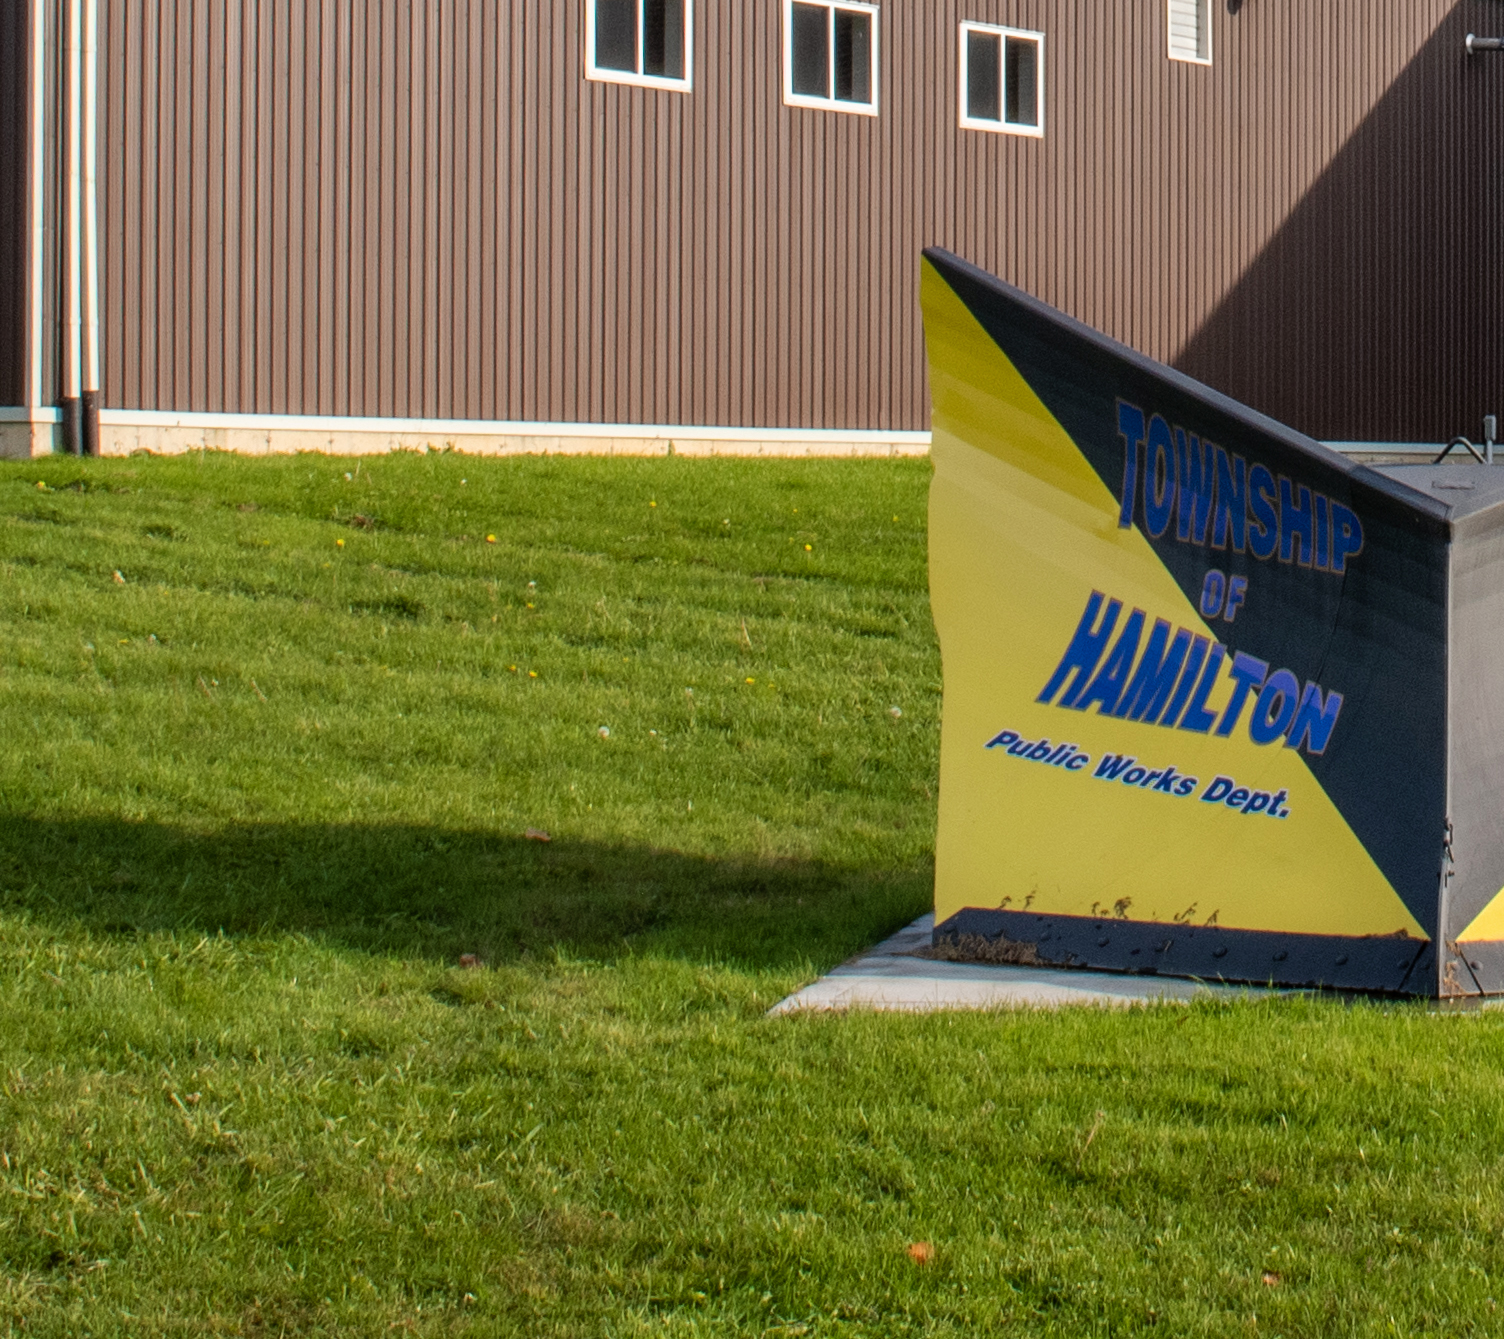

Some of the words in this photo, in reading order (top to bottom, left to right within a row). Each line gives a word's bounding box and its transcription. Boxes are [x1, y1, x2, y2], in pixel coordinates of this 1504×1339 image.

[1116, 397, 1364, 574] TOWNSHIP
[1200, 570, 1247, 622] OF
[1034, 589, 1344, 755] HAMILTON
[985, 729, 1090, 770] Public
[1093, 753, 1198, 797] Works
[1199, 775, 1291, 818] Dept.
